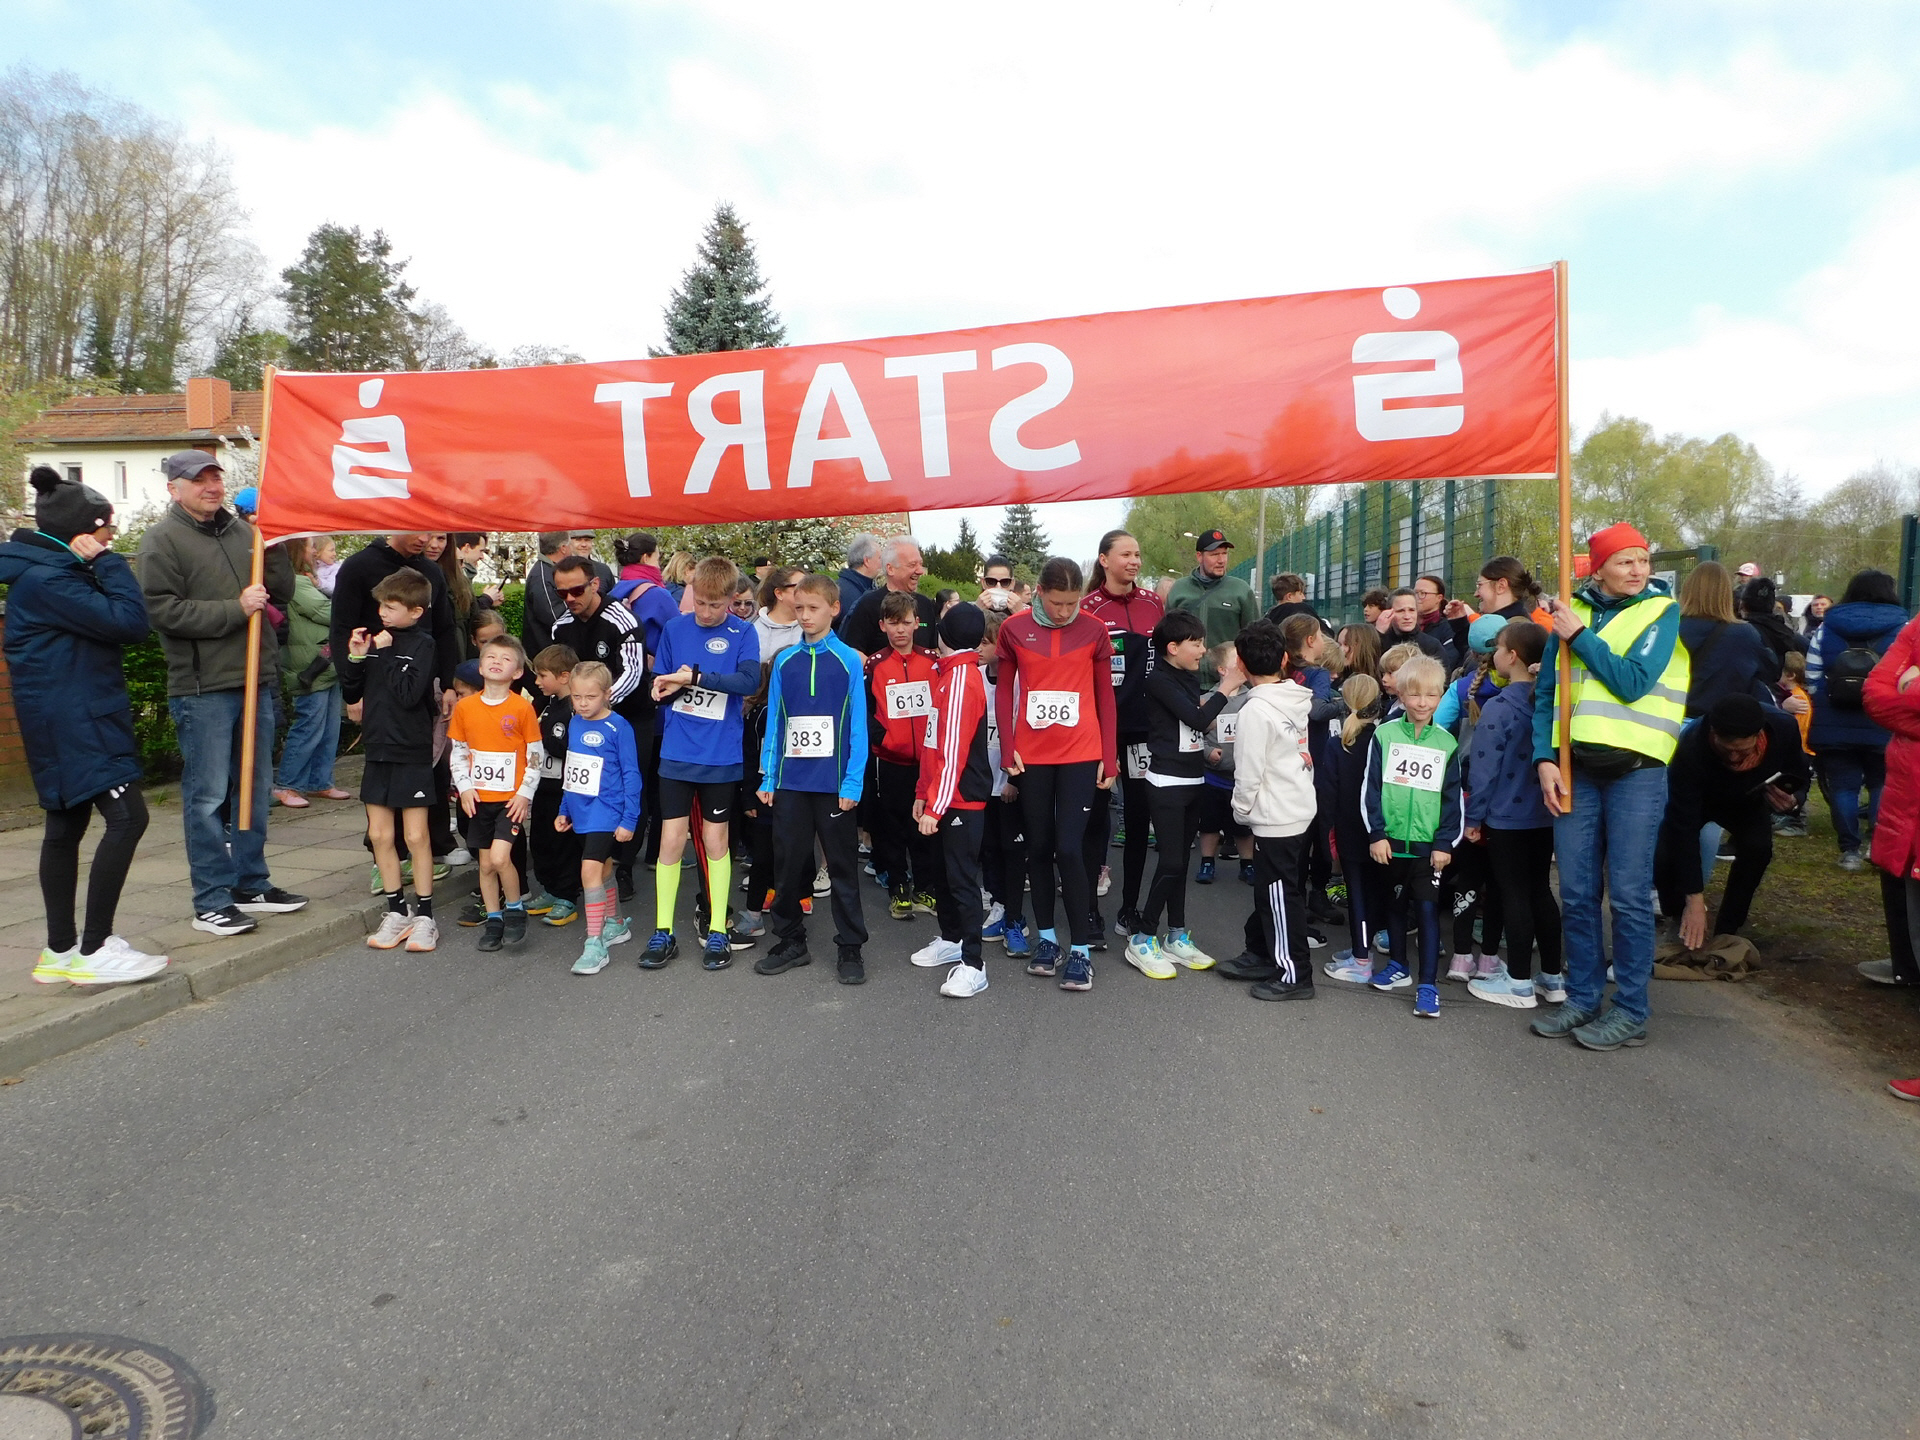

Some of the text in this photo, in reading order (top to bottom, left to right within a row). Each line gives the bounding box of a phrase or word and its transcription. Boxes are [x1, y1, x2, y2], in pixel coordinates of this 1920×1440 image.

[683, 688, 717, 708] 557
[896, 694, 924, 709] 613
[1036, 704, 1070, 720] 386
[791, 731, 822, 747] 383
[1138, 755, 1151, 769] 5
[1396, 759, 1433, 780] 496
[474, 765, 505, 782] 394
[566, 766, 590, 785] 558
